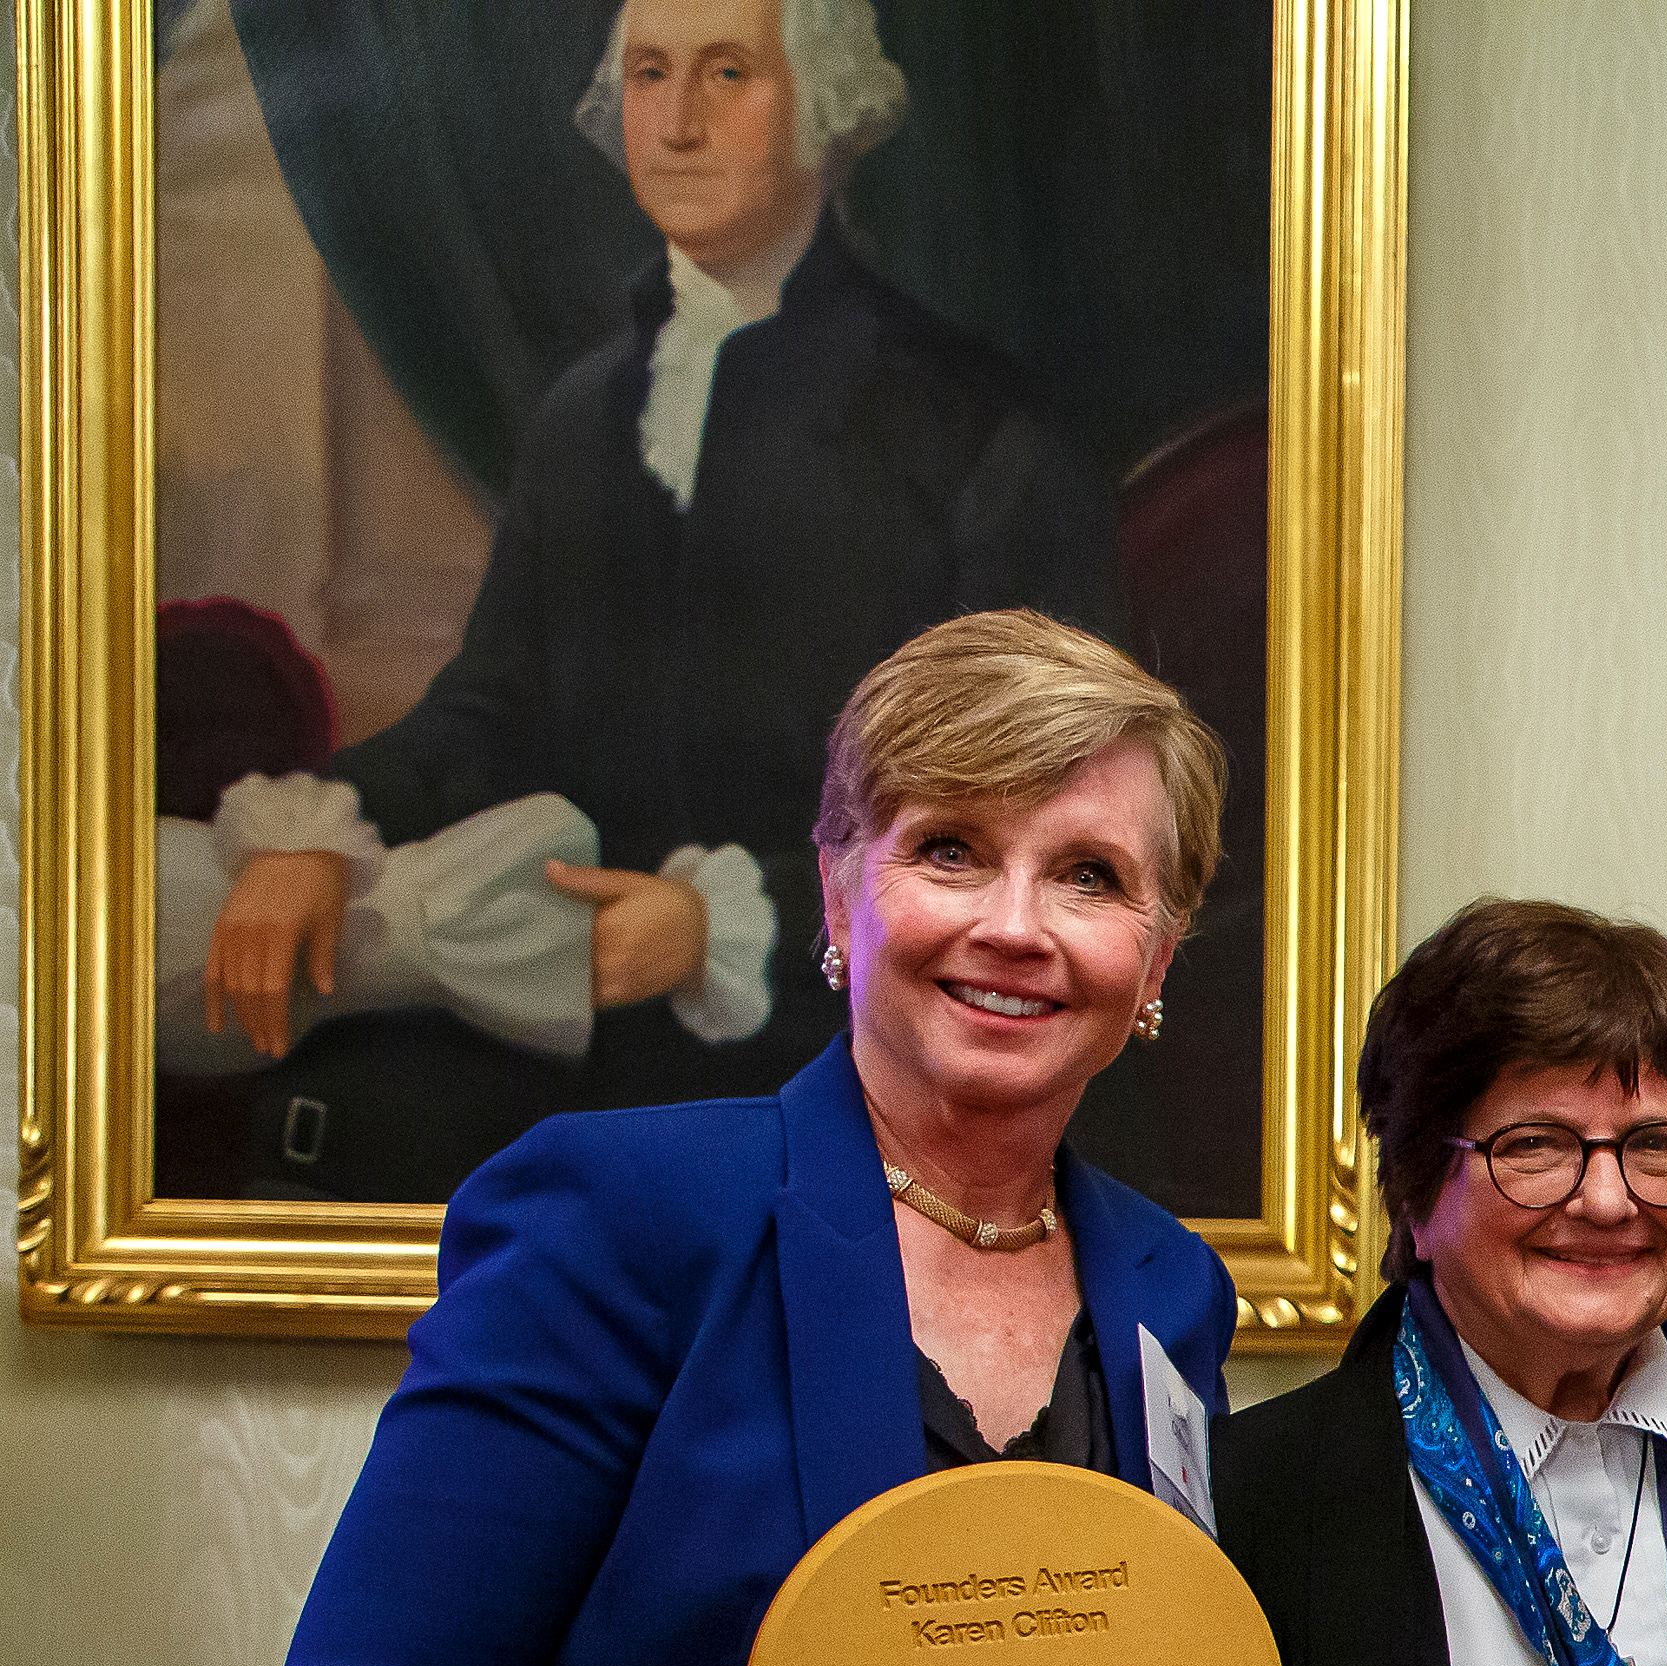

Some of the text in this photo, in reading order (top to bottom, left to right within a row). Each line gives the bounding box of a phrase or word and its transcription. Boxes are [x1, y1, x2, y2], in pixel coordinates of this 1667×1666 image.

[879, 1560, 1129, 1609] Founders Award
[911, 1607, 1110, 1648] Karen Clifton
